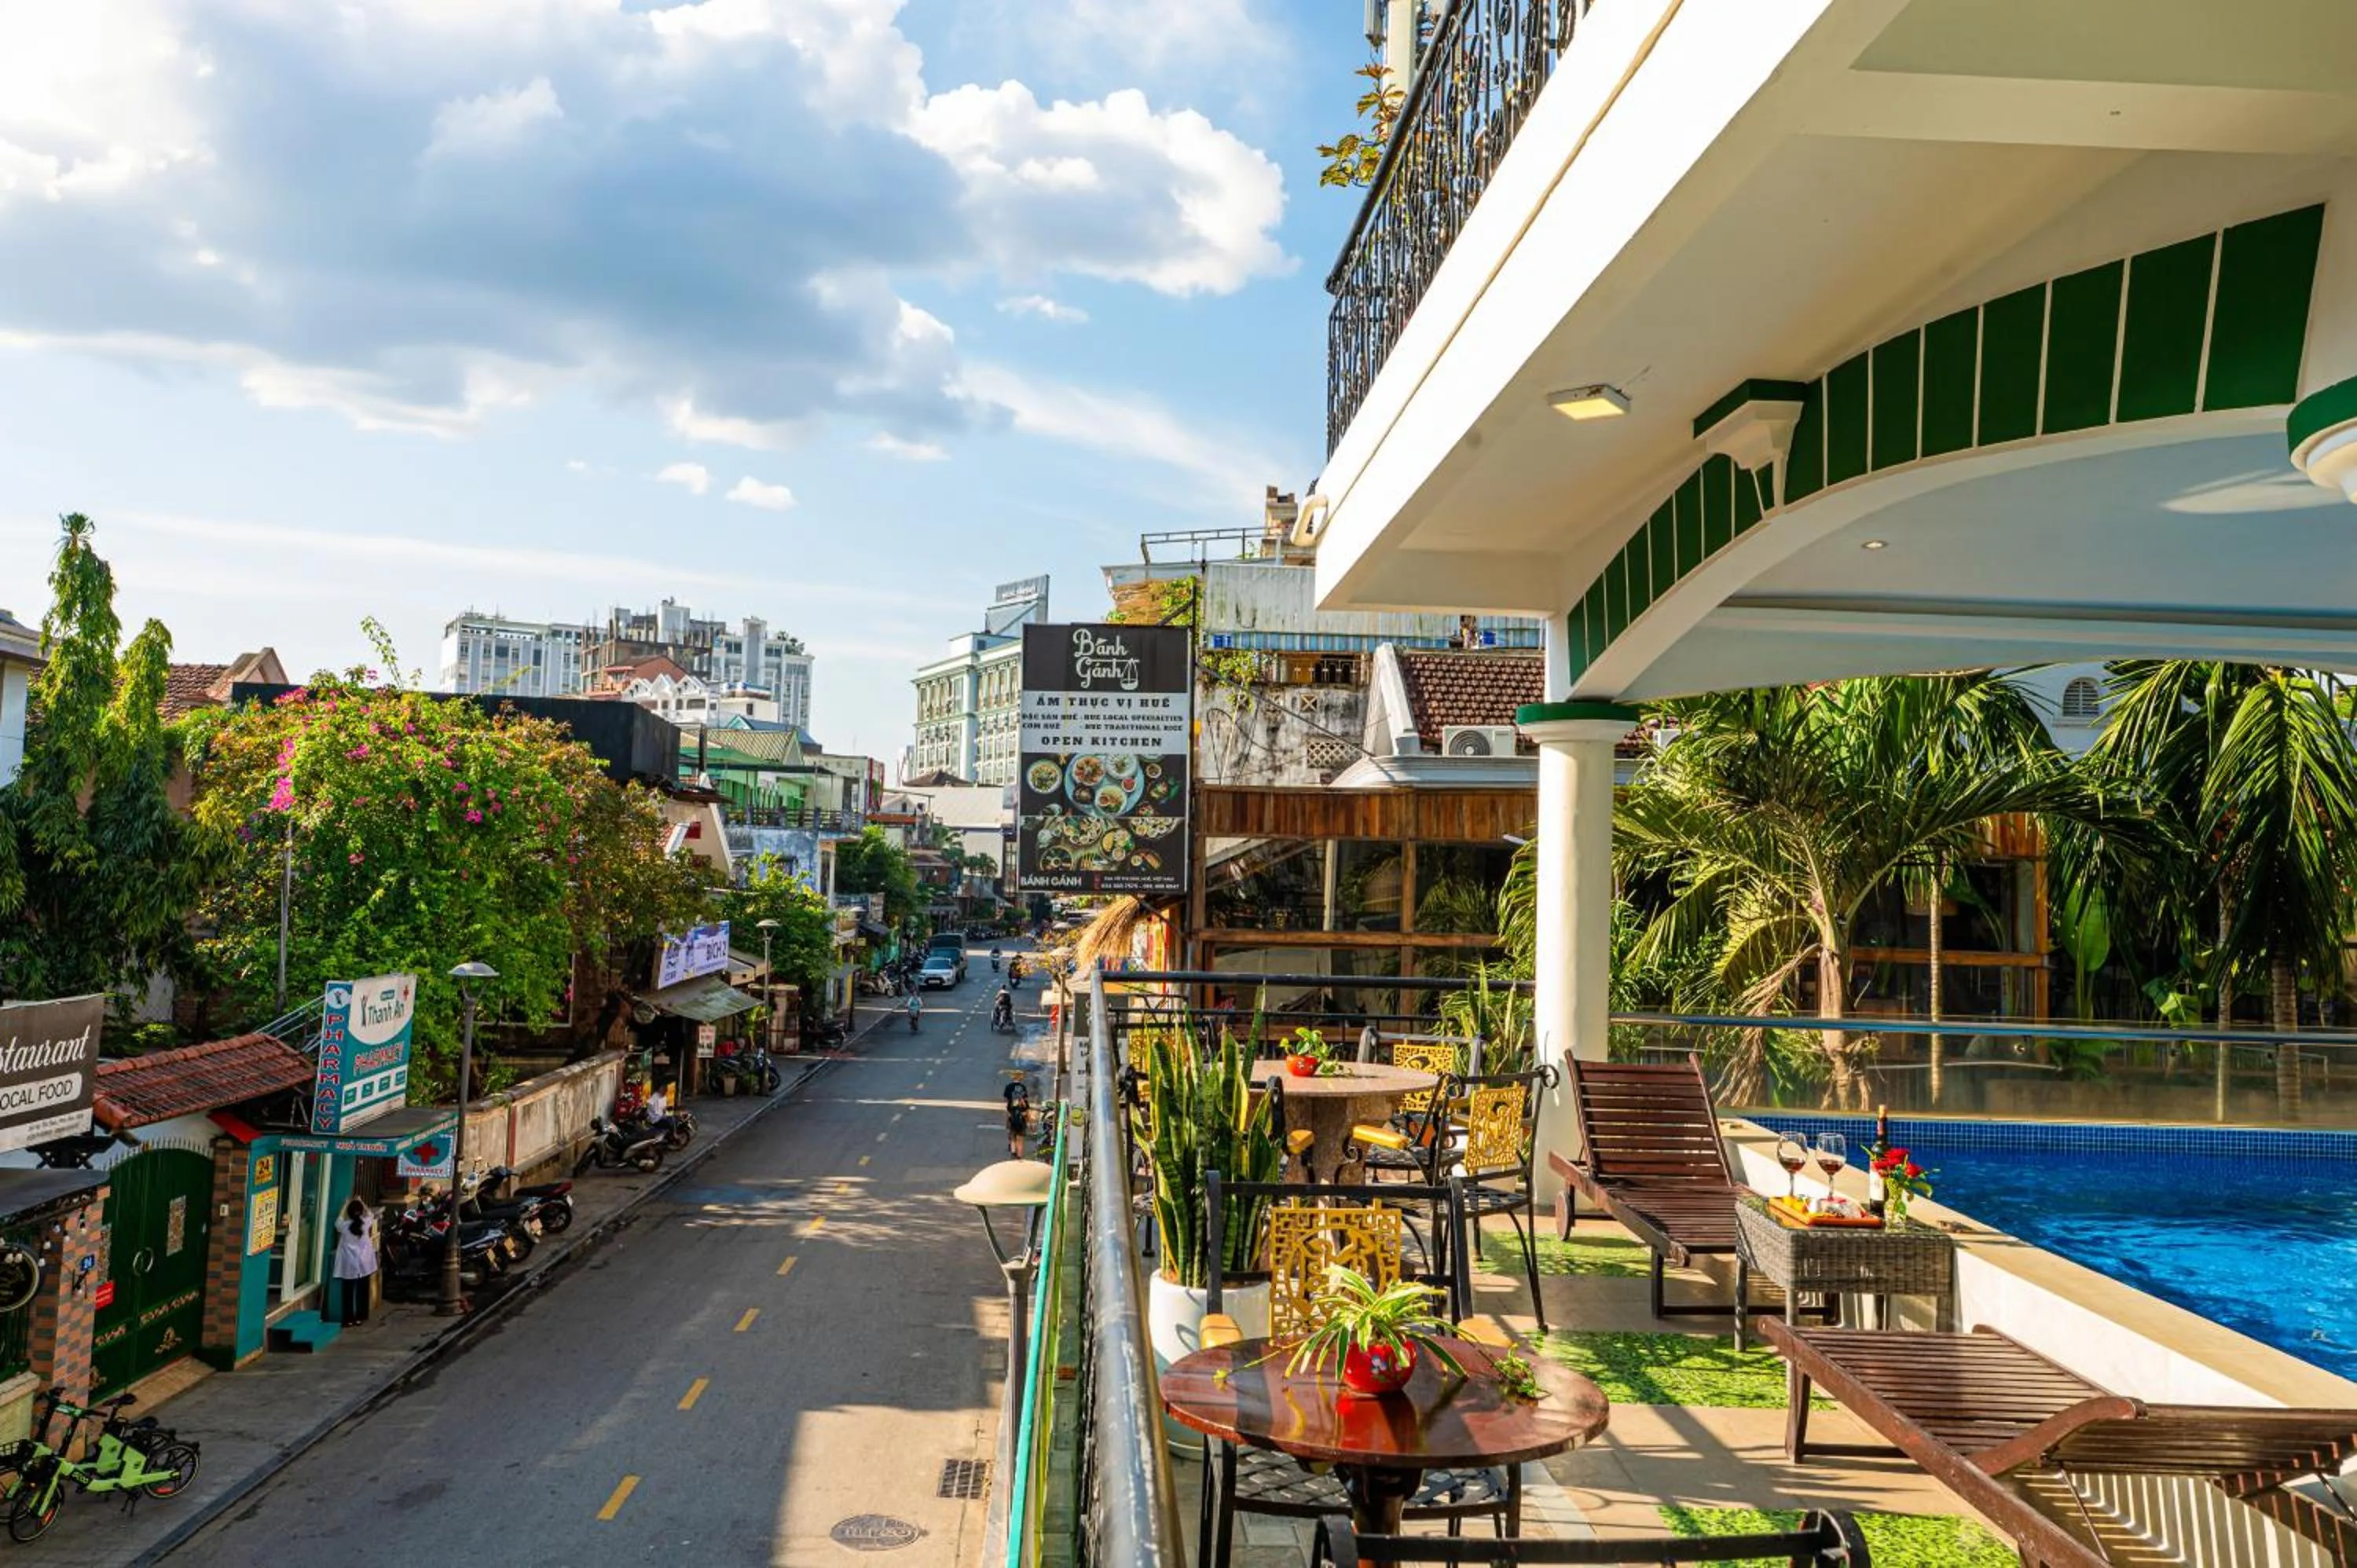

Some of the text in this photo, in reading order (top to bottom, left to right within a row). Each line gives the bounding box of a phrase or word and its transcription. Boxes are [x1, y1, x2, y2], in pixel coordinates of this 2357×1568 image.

[1072, 628, 1129, 658] Bánh
[1076, 657, 1124, 689] Gánh
[1041, 736, 1162, 746] OPEN KITCHEN
[1021, 874, 1049, 886] BÁNH
[317, 1013, 344, 1130] PHARMACY
[38, 1079, 74, 1101] FOOD
